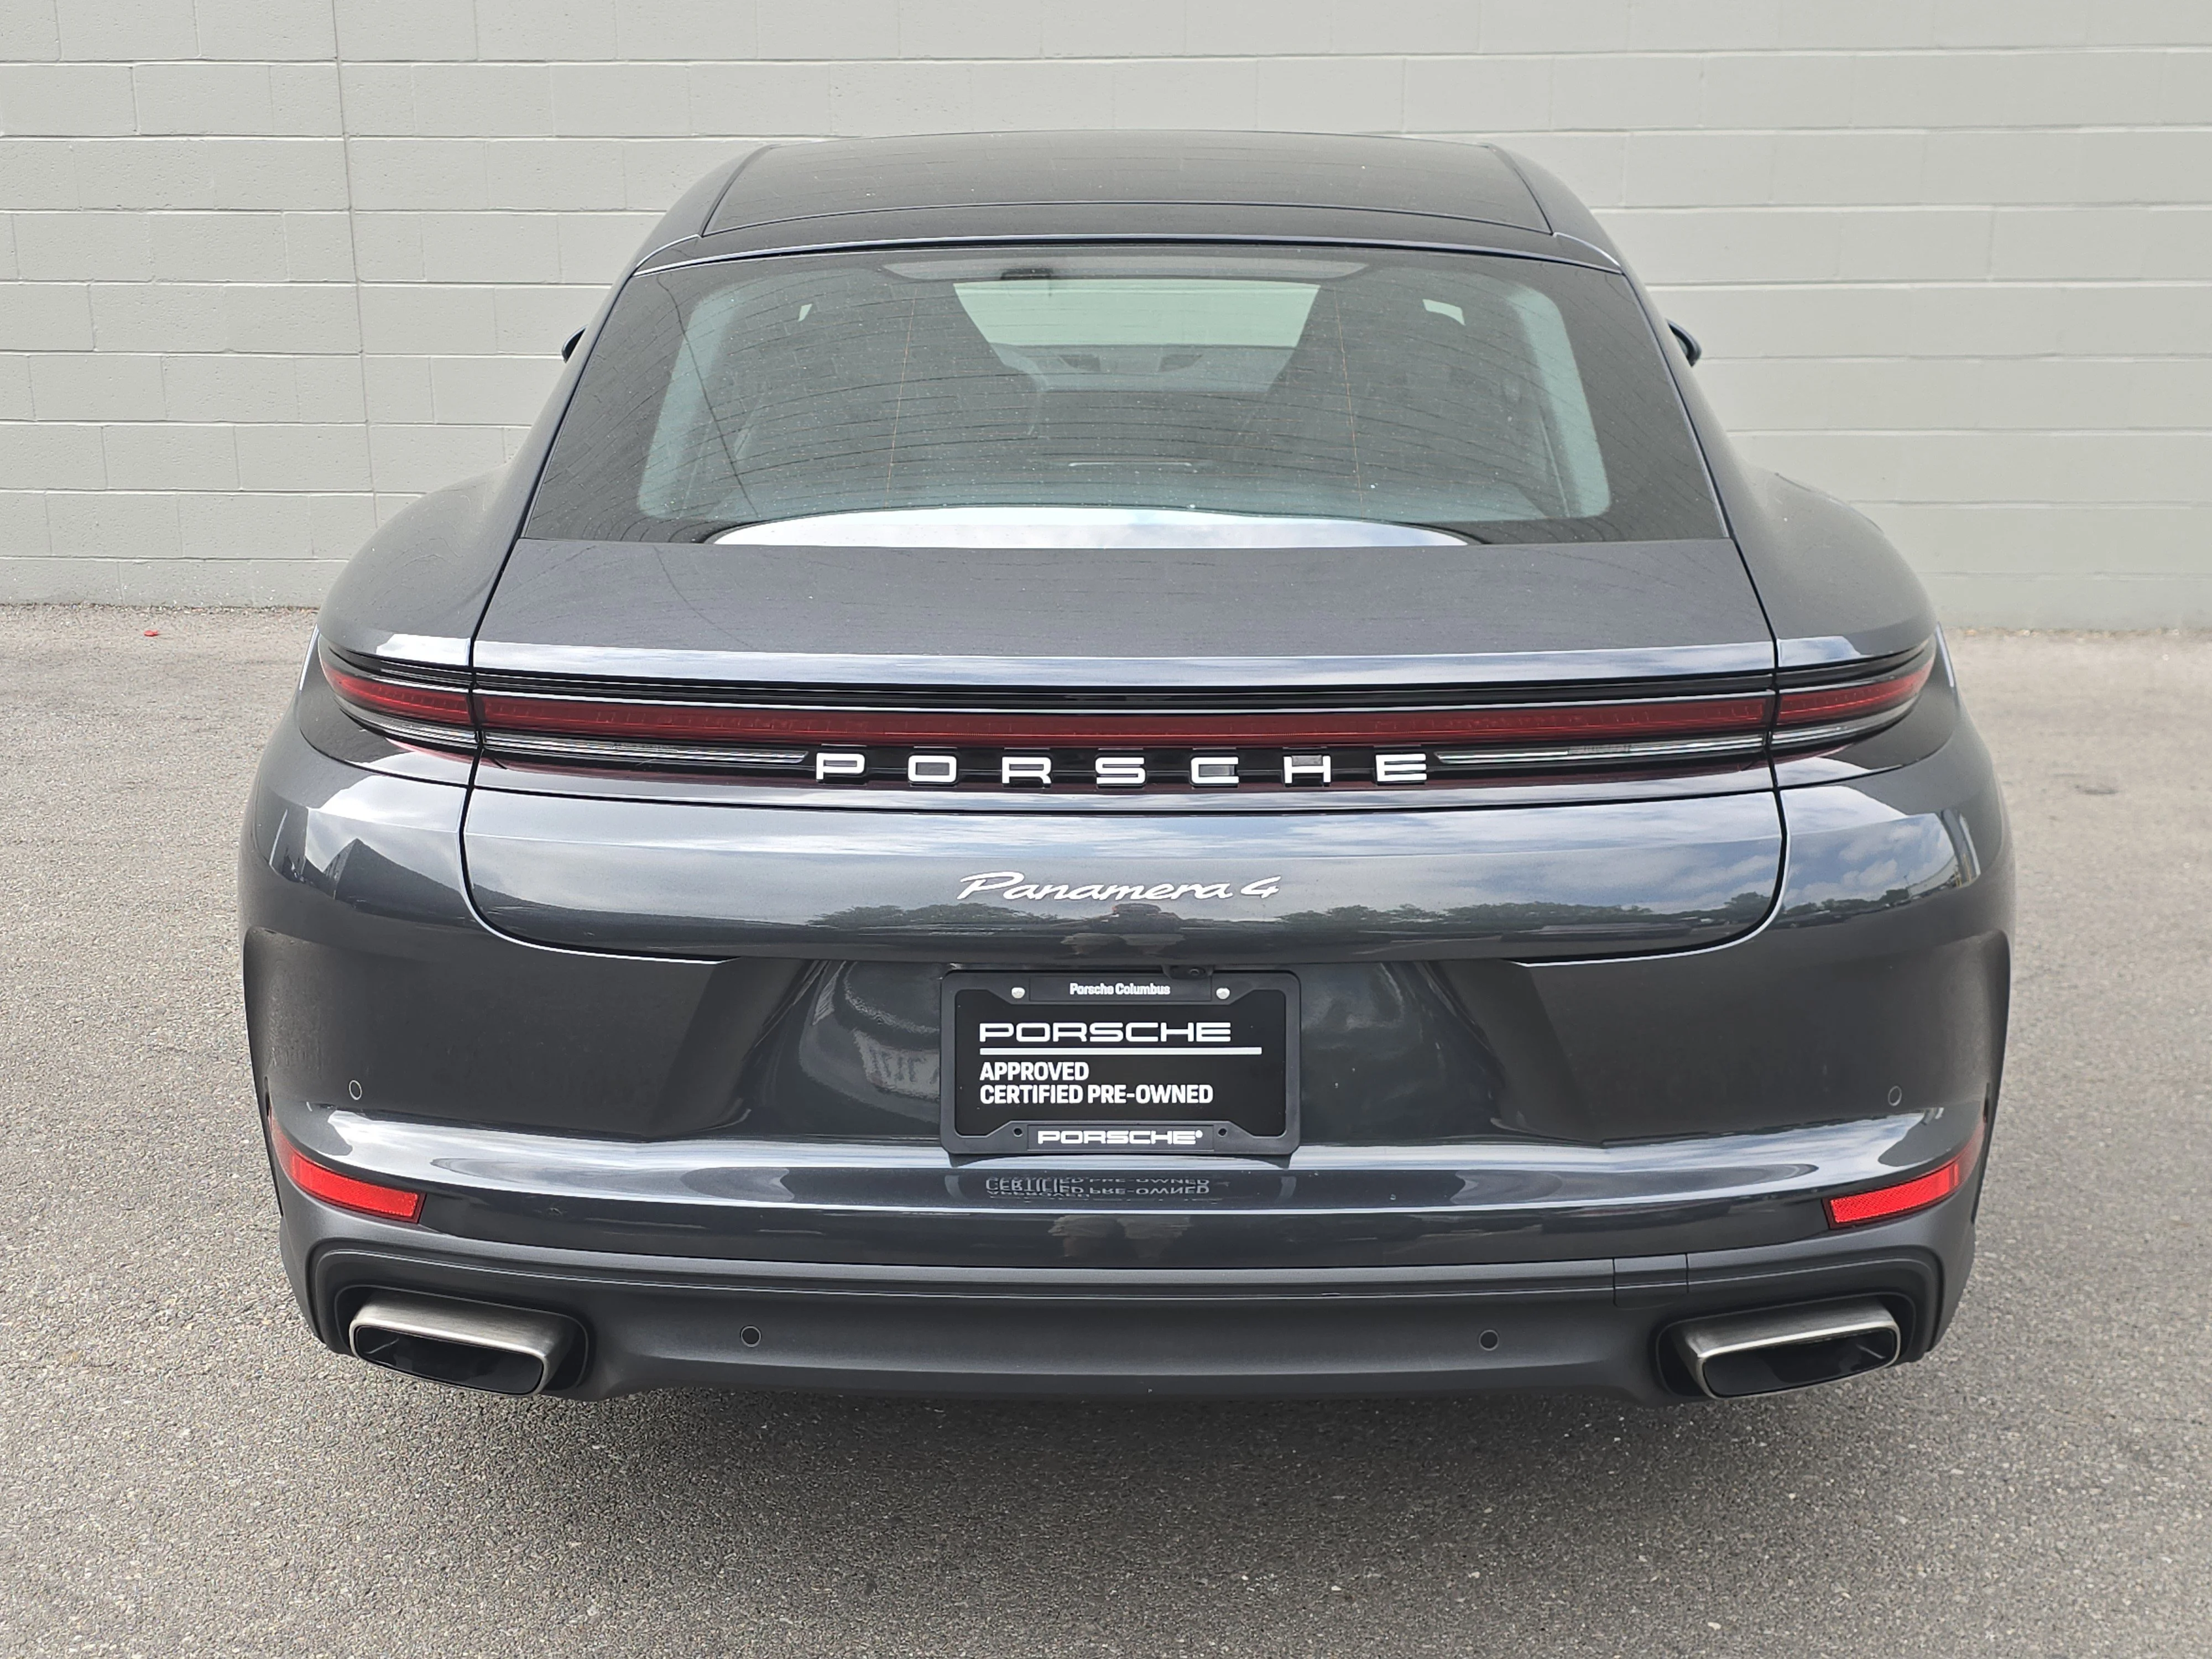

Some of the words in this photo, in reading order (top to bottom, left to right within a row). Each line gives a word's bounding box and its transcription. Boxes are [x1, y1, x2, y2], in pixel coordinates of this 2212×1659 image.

[816, 752, 1427, 784] PORSCHE
[957, 871, 1233, 901] Panamera
[1240, 875, 1281, 900] 4
[1070, 982, 1114, 995] Porsche
[1115, 982, 1171, 995] Columbus
[979, 1022, 1231, 1042] PORSCHE
[979, 1061, 1089, 1081] APPROVED
[980, 1084, 1083, 1104] CERTIFIED
[1087, 1084, 1213, 1104] PRE-OWNED
